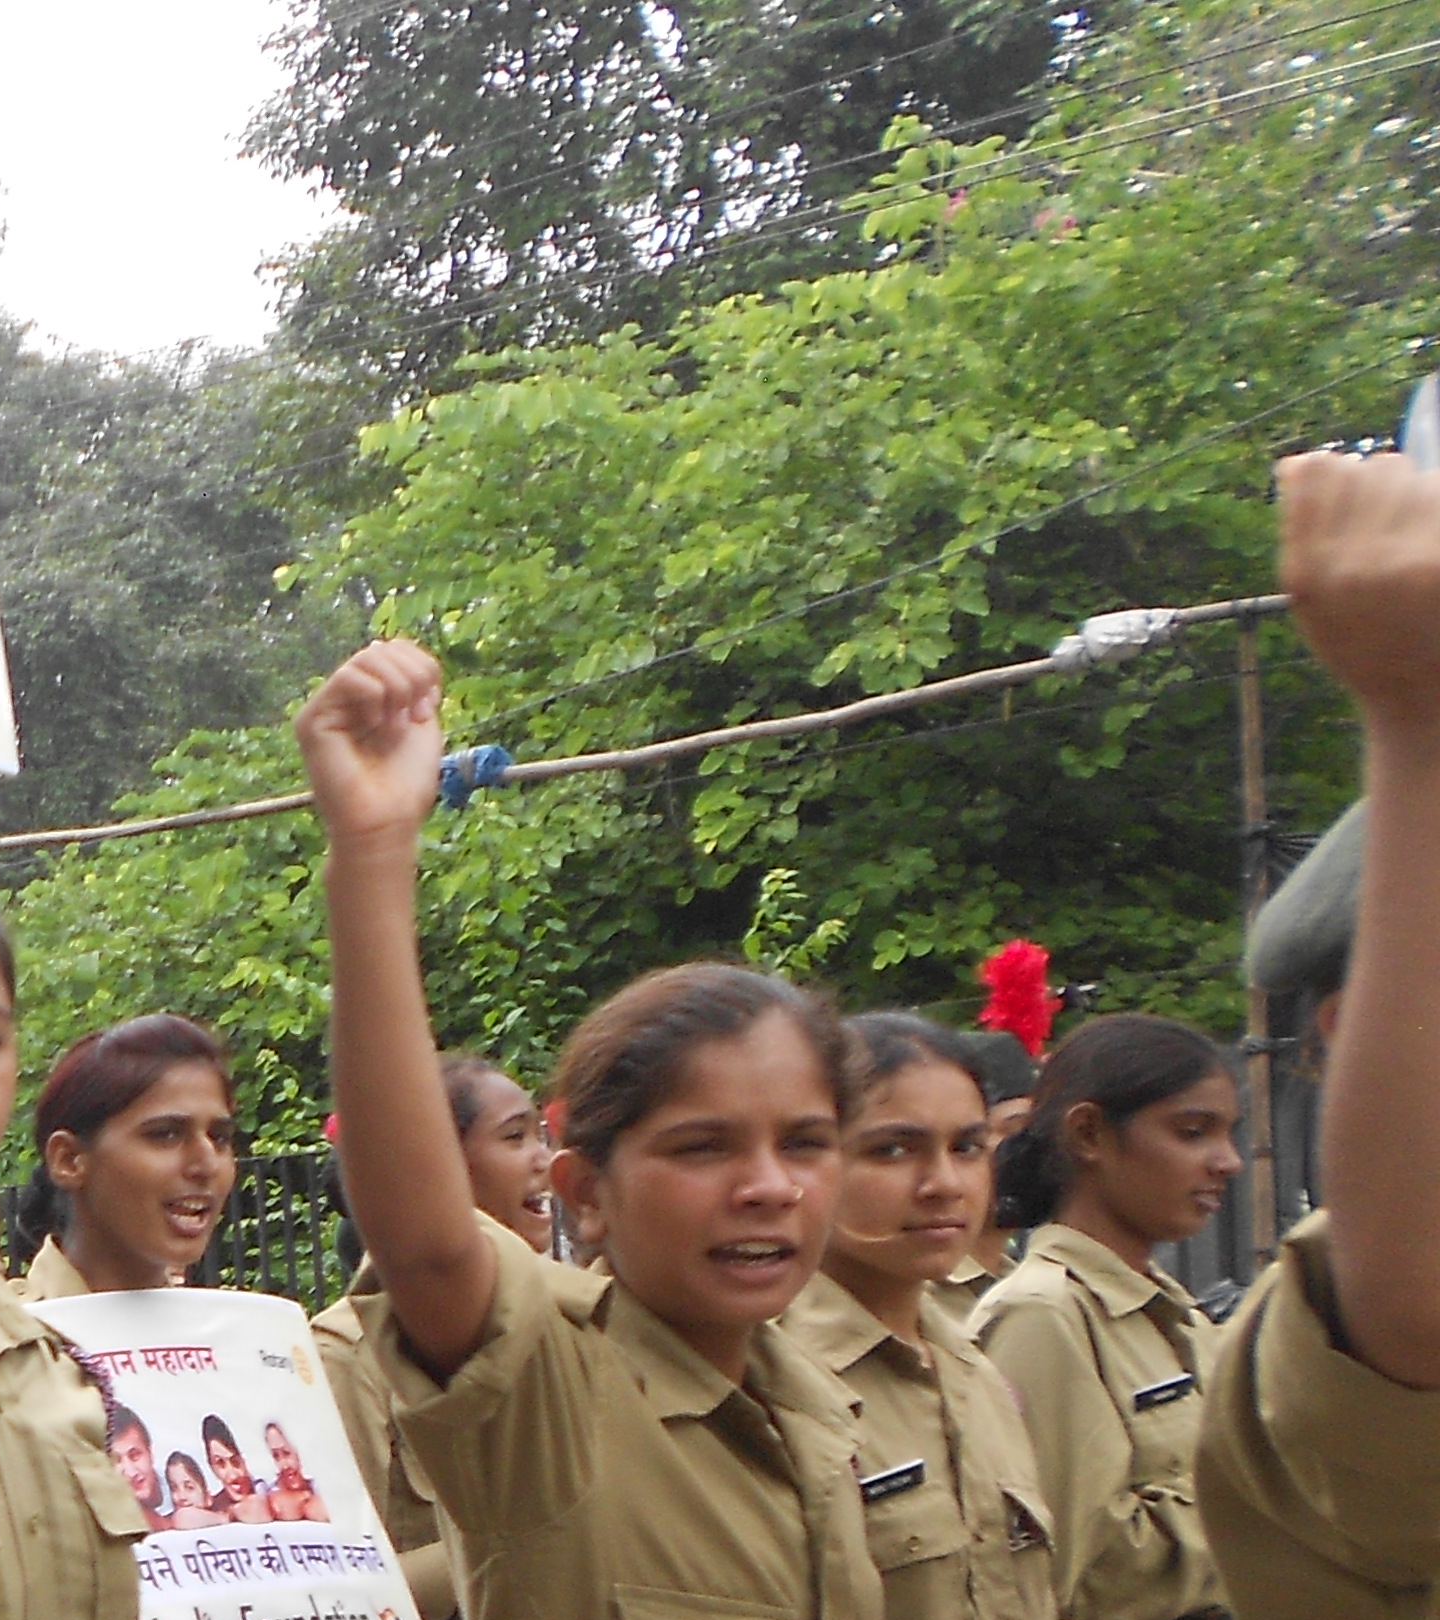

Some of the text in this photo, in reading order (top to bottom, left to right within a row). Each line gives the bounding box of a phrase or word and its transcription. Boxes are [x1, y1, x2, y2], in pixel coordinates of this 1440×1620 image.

[139, 1346, 218, 1376] महादान
[137, 1544, 183, 1591] पने
[182, 1538, 263, 1584] परिवार
[256, 1532, 291, 1577] की
